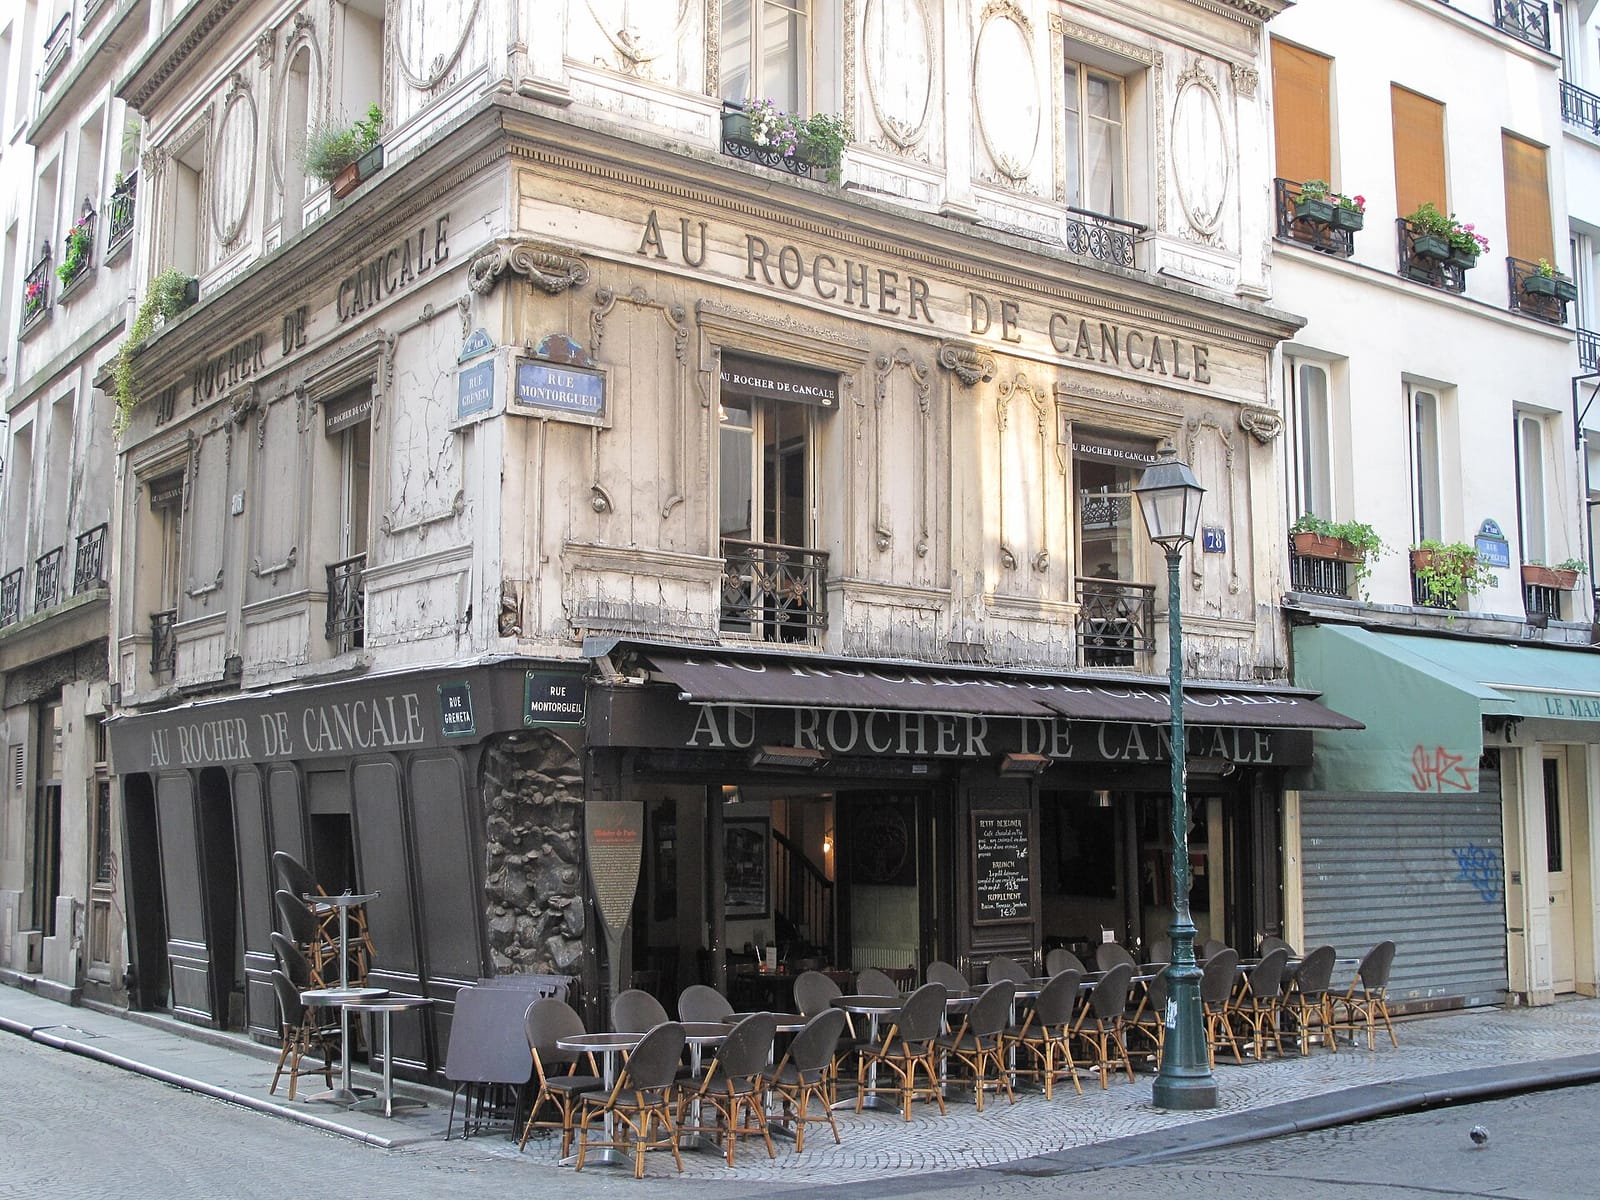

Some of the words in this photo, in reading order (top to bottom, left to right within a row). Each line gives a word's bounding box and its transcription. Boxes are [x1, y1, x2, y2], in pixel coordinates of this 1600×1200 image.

[636, 209, 708, 267] AU
[744, 233, 935, 323] ROCHER
[969, 291, 1022, 344] DE
[1048, 311, 1211, 385] CANCALE
[155, 384, 177, 427] AU
[191, 332, 266, 407] ROCHER
[281, 304, 310, 357] DE
[335, 215, 450, 323] CANCALE
[469, 374, 483, 390] RUE
[547, 373, 574, 389] RUE
[719, 371, 731, 382] AU
[733, 374, 775, 389] ROCHER
[777, 382, 791, 392] DE
[792, 384, 835, 399] CANCALE
[519, 385, 598, 407] MONTORGUEIL
[1072, 443, 1079, 451] U
[1080, 444, 1112, 456] ROCHER
[1113, 449, 1124, 458] DE
[1124, 451, 1156, 463] CANCALE
[1208, 532, 1223, 549] 78
[550, 686, 567, 697] RUE
[449, 696, 462, 707] RUE
[531, 701, 583, 713] MONTORGUEIL
[1544, 697, 1565, 716] LE
[444, 711, 471, 724] GRENETA
[151, 728, 171, 767] AU
[178, 717, 252, 764] ROCHER
[260, 711, 294, 757] DE
[302, 692, 425, 752] CANCALE
[685, 703, 756, 749] AU
[793, 707, 992, 757] ROCHER
[1020, 716, 1074, 759] DE
[1097, 720, 1274, 764] CANCALE
[992, 861, 1015, 869] BRUNCH
